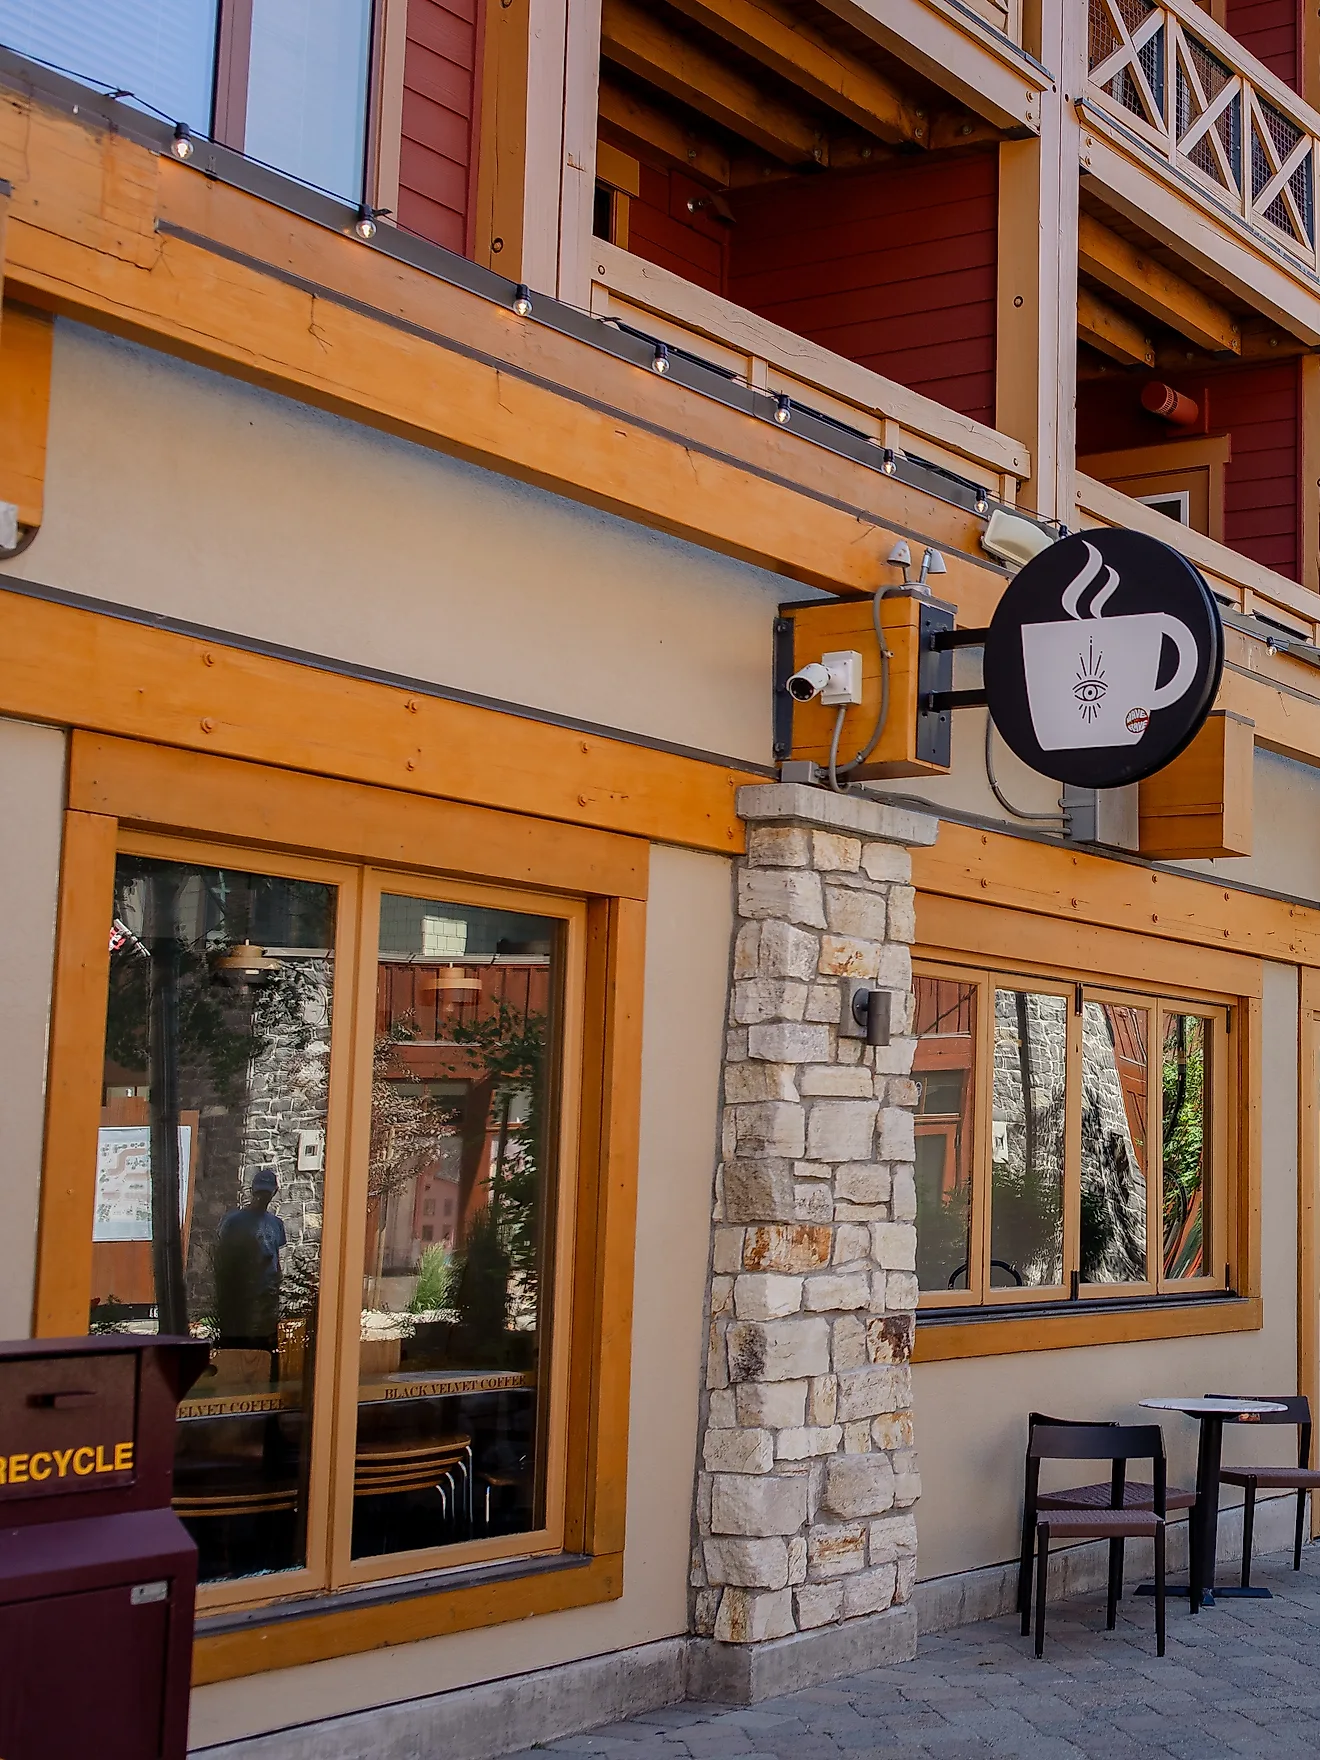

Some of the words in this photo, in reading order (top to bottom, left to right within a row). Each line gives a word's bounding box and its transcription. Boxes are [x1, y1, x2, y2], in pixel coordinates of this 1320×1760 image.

[384, 1384, 430, 1401] BLACK
[431, 1379, 479, 1395] VELVET
[480, 1375, 527, 1390] COFFEE
[178, 1404, 226, 1419] ELVET
